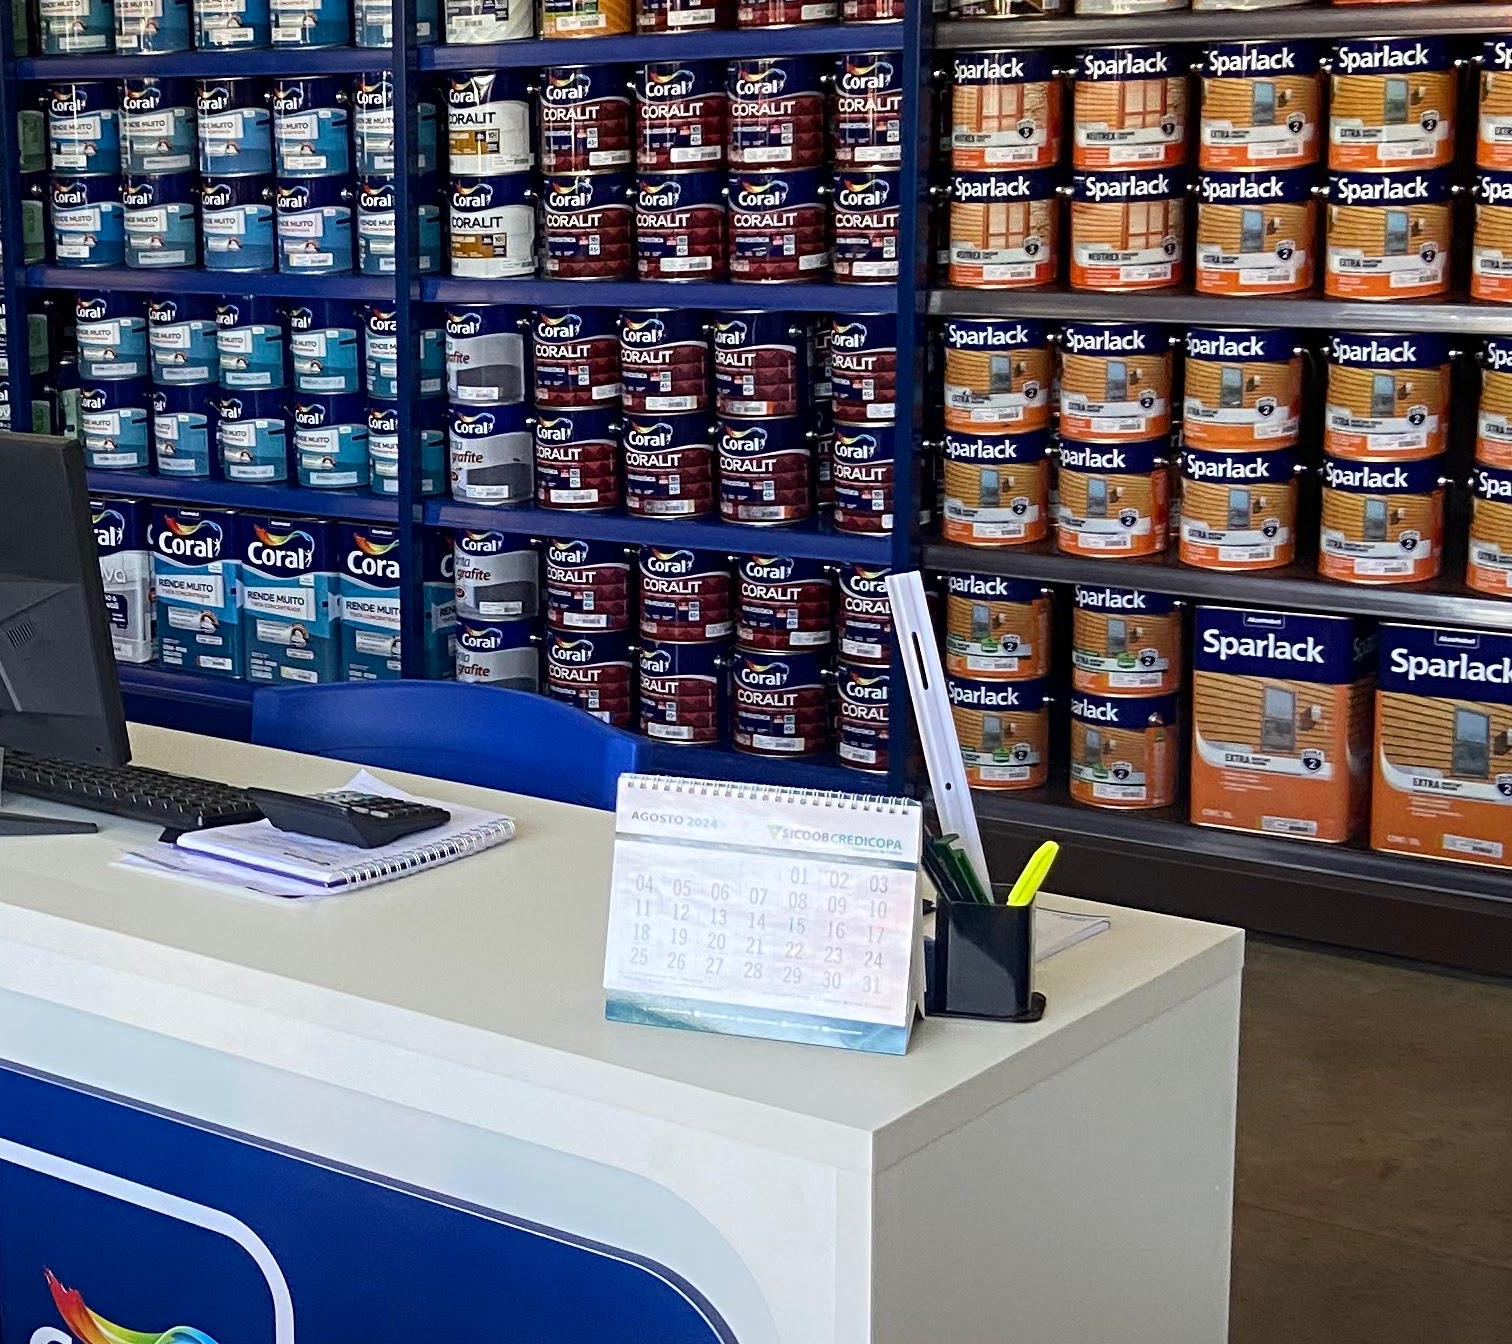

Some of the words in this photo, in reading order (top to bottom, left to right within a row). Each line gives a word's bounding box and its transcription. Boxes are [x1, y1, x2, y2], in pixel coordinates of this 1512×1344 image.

[1085, 52, 1168, 79] Sparlack
[1209, 48, 1295, 75] Sparlack
[1339, 46, 1428, 73] Sparlack
[546, 84, 583, 100] Coral
[646, 80, 687, 97] Coral
[736, 79, 778, 95] Coral
[52, 99, 82, 112] Coral
[543, 106, 599, 121] CORALIT
[641, 103, 703, 119] CORALIT
[732, 101, 795, 117] CORALIT
[1086, 174, 1169, 201] Sparlack
[1338, 177, 1428, 203] Sparlack
[453, 193, 486, 207] Coral
[550, 192, 587, 207] Coral
[738, 190, 780, 206] Coral
[840, 190, 880, 206] Coral
[452, 216, 503, 228] CORALIT
[547, 214, 602, 228] CORALIT
[734, 212, 797, 227] CORALIT
[835, 213, 899, 227] CORALIT
[538, 323, 574, 337] Coral
[949, 325, 1028, 347] Sparlack
[1067, 329, 1145, 352] Sparlack
[536, 345, 590, 357] CORALIT
[1333, 338, 1416, 363] Sparlack
[629, 432, 665, 447] Coral
[722, 435, 759, 451] Coral
[720, 457, 777, 472] CORALIT
[1326, 462, 1408, 488] Sparlack
[158, 531, 214, 558] Coral
[462, 538, 496, 552] Coral
[248, 541, 304, 569] Coral
[347, 550, 400, 578] Cora
[648, 559, 686, 573] Coral
[457, 569, 491, 581] grafite
[159, 578, 186, 590] RENDE
[188, 582, 214, 593] MUITO
[643, 578, 702, 593] CORALIT
[742, 583, 802, 600] CORALIT
[248, 590, 275, 602] RENDE
[276, 595, 305, 606] MUITO
[1075, 585, 1146, 608] Sparlack
[346, 601, 373, 612] RENDE
[375, 605, 400, 615] MUIT
[552, 646, 585, 662] Coral
[1203, 629, 1324, 664] Sparlack
[549, 665, 601, 681] CORALIT
[1390, 648, 1512, 683] Sparlack
[742, 669, 781, 686] Coral
[948, 681, 1019, 705] Sparlack
[1225, 753, 1250, 764] EXTRA
[1413, 777, 1440, 788] EXTRA
[632, 811, 684, 826] AGOSTO
[687, 816, 718, 829] 2024
[791, 866, 807, 885] 01
[830, 871, 849, 889] 02
[869, 875, 888, 893] 03
[636, 875, 654, 892] 04
[673, 879, 691, 896] 05
[711, 883, 730, 901] 06
[750, 887, 768, 905] 07
[789, 892, 807, 910] 08
[828, 896, 847, 914] 09
[870, 900, 887, 918] 10
[636, 899, 649, 917] 11
[673, 904, 689, 921] 12
[711, 908, 727, 925] 13
[749, 912, 766, 930] 14
[789, 917, 805, 935] 15
[828, 921, 845, 939] 16
[868, 927, 884, 944] 17
[634, 923, 650, 941] 18
[672, 928, 687, 945] 19
[707, 932, 726, 950] 20
[746, 937, 763, 954] 21
[785, 941, 804, 960] 22
[824, 946, 842, 964] 23
[864, 951, 882, 968] 24
[630, 948, 648, 966] 25
[668, 952, 685, 970] 26
[706, 957, 723, 975] 27
[744, 962, 763, 979] 28
[783, 967, 802, 984] 29
[823, 971, 841, 989] 30
[862, 975, 879, 994] 31
